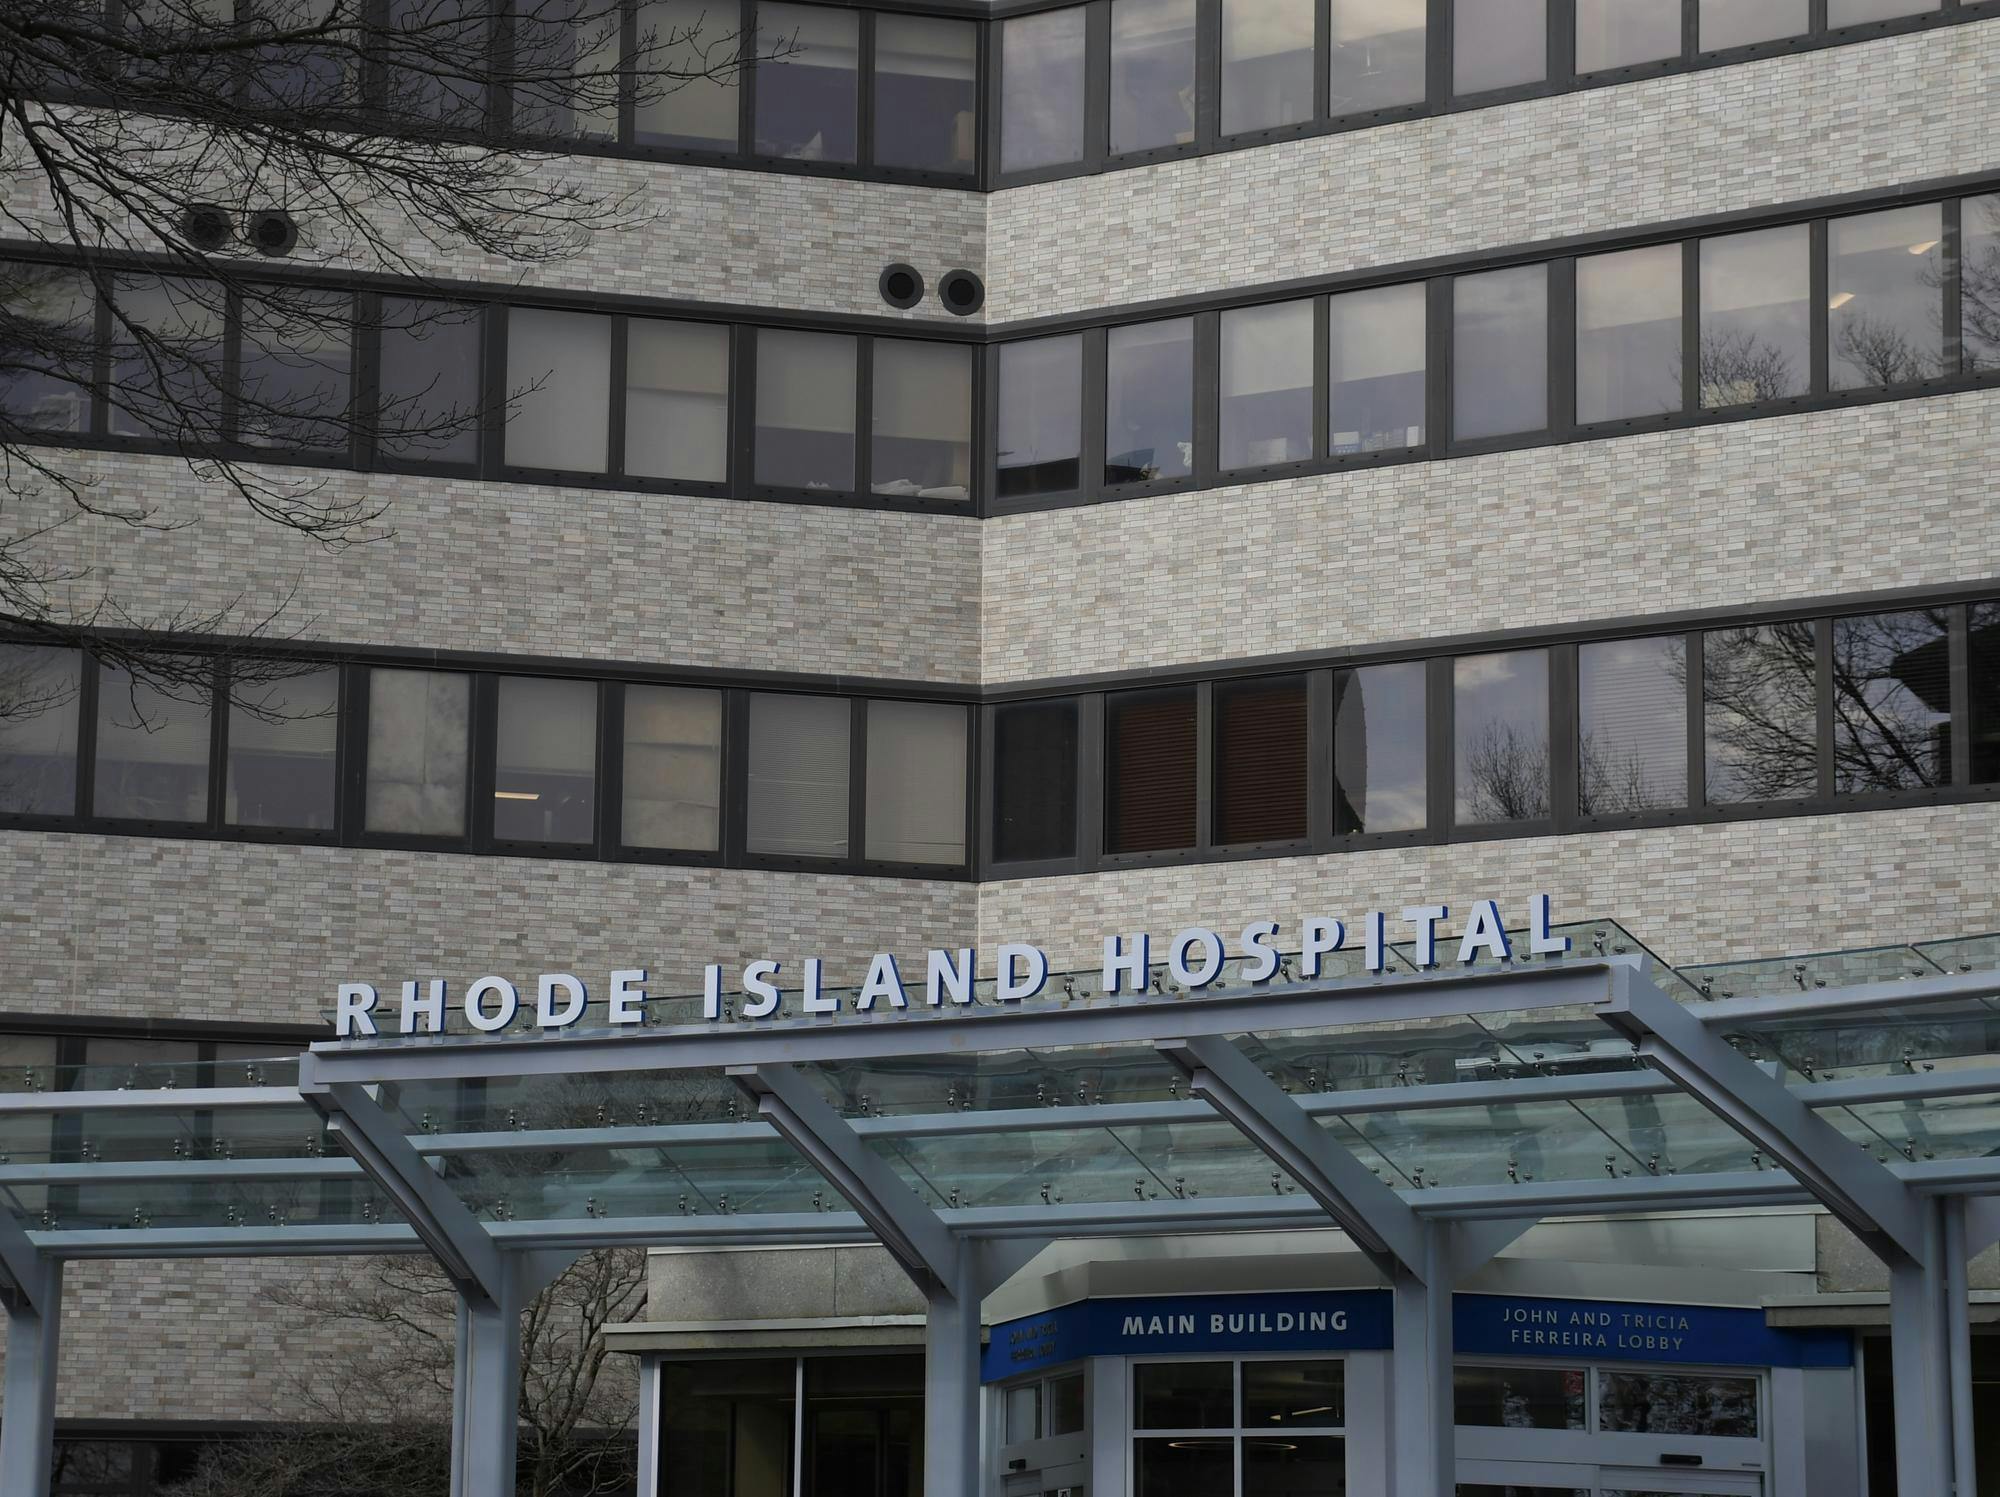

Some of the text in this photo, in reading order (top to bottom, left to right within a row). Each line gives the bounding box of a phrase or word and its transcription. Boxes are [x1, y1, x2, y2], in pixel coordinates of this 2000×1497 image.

[336, 894, 1571, 1036] RHODE ISLAND HOSPITAL
[1122, 1311, 1348, 1335] MAIN BUILDING
[1503, 1308, 1689, 1330] JOHN AND TRICIA
[1511, 1330, 1683, 1350] FERREIRA LOBBY
